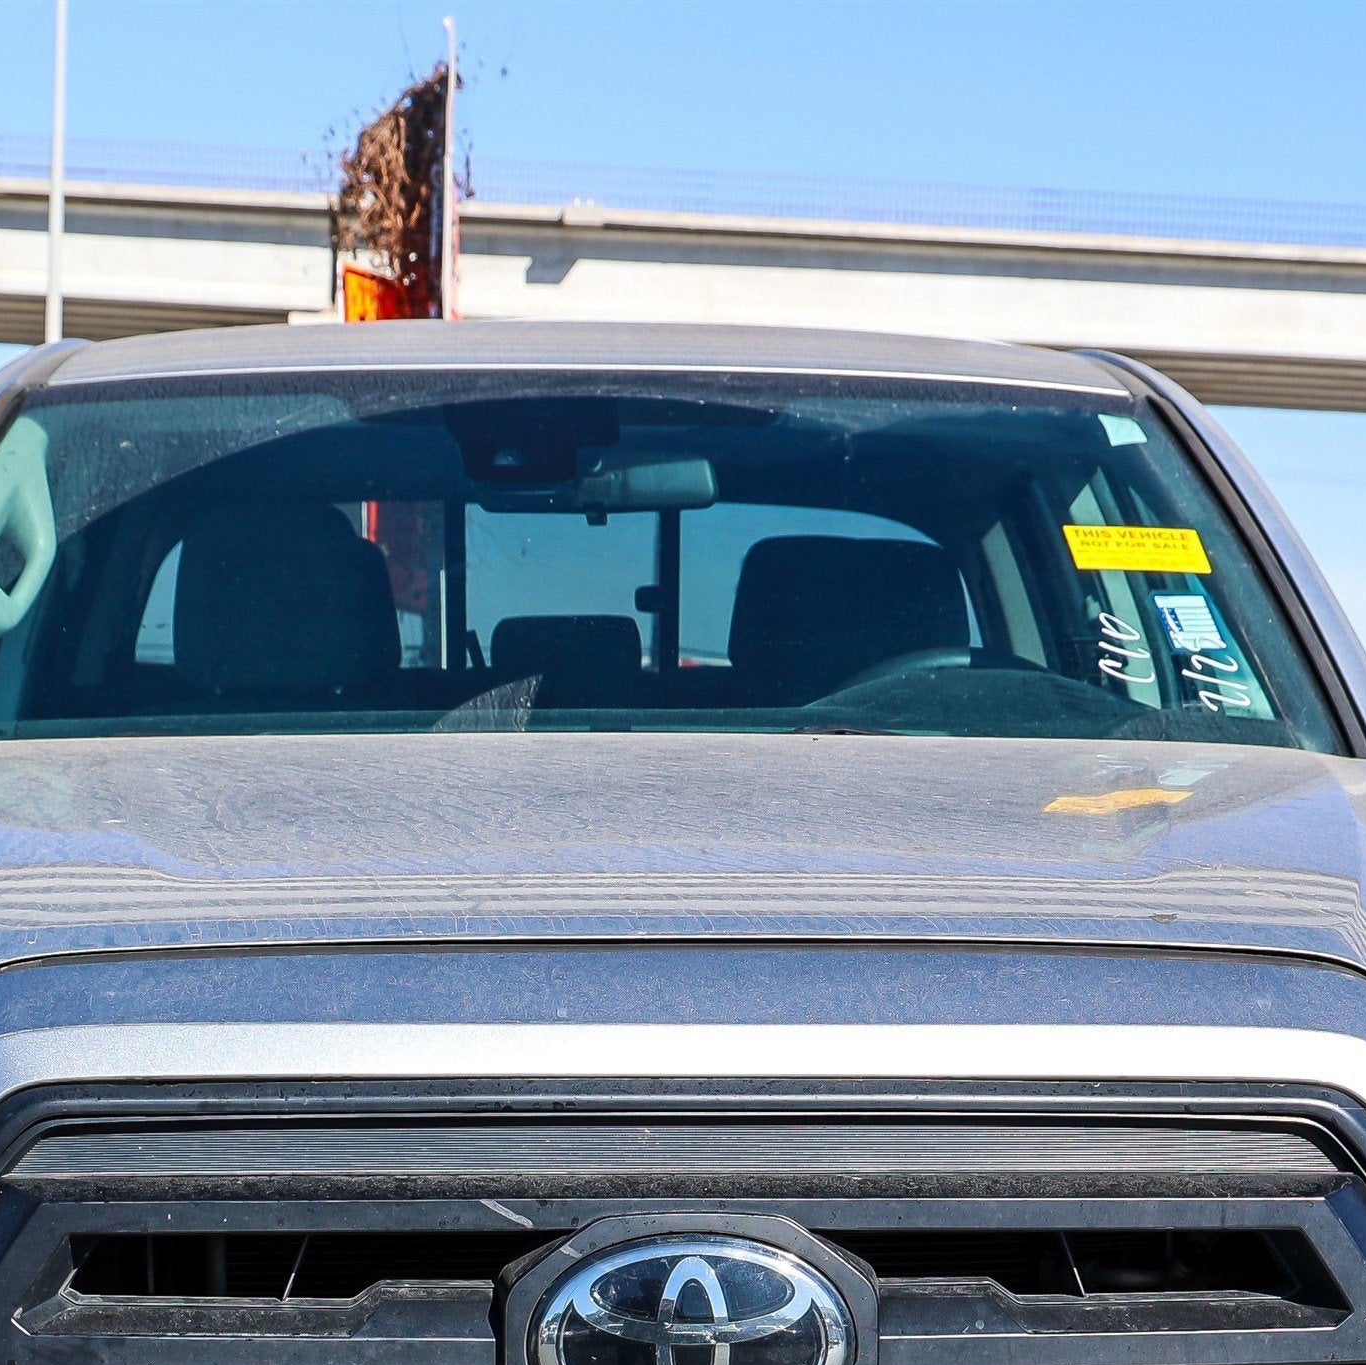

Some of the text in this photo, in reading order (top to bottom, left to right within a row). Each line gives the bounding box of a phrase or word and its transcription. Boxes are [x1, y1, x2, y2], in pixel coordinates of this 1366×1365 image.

[1073, 529, 1190, 541] THIS VEHICLE
[1080, 540, 1190, 550] NOT FOR SALE
